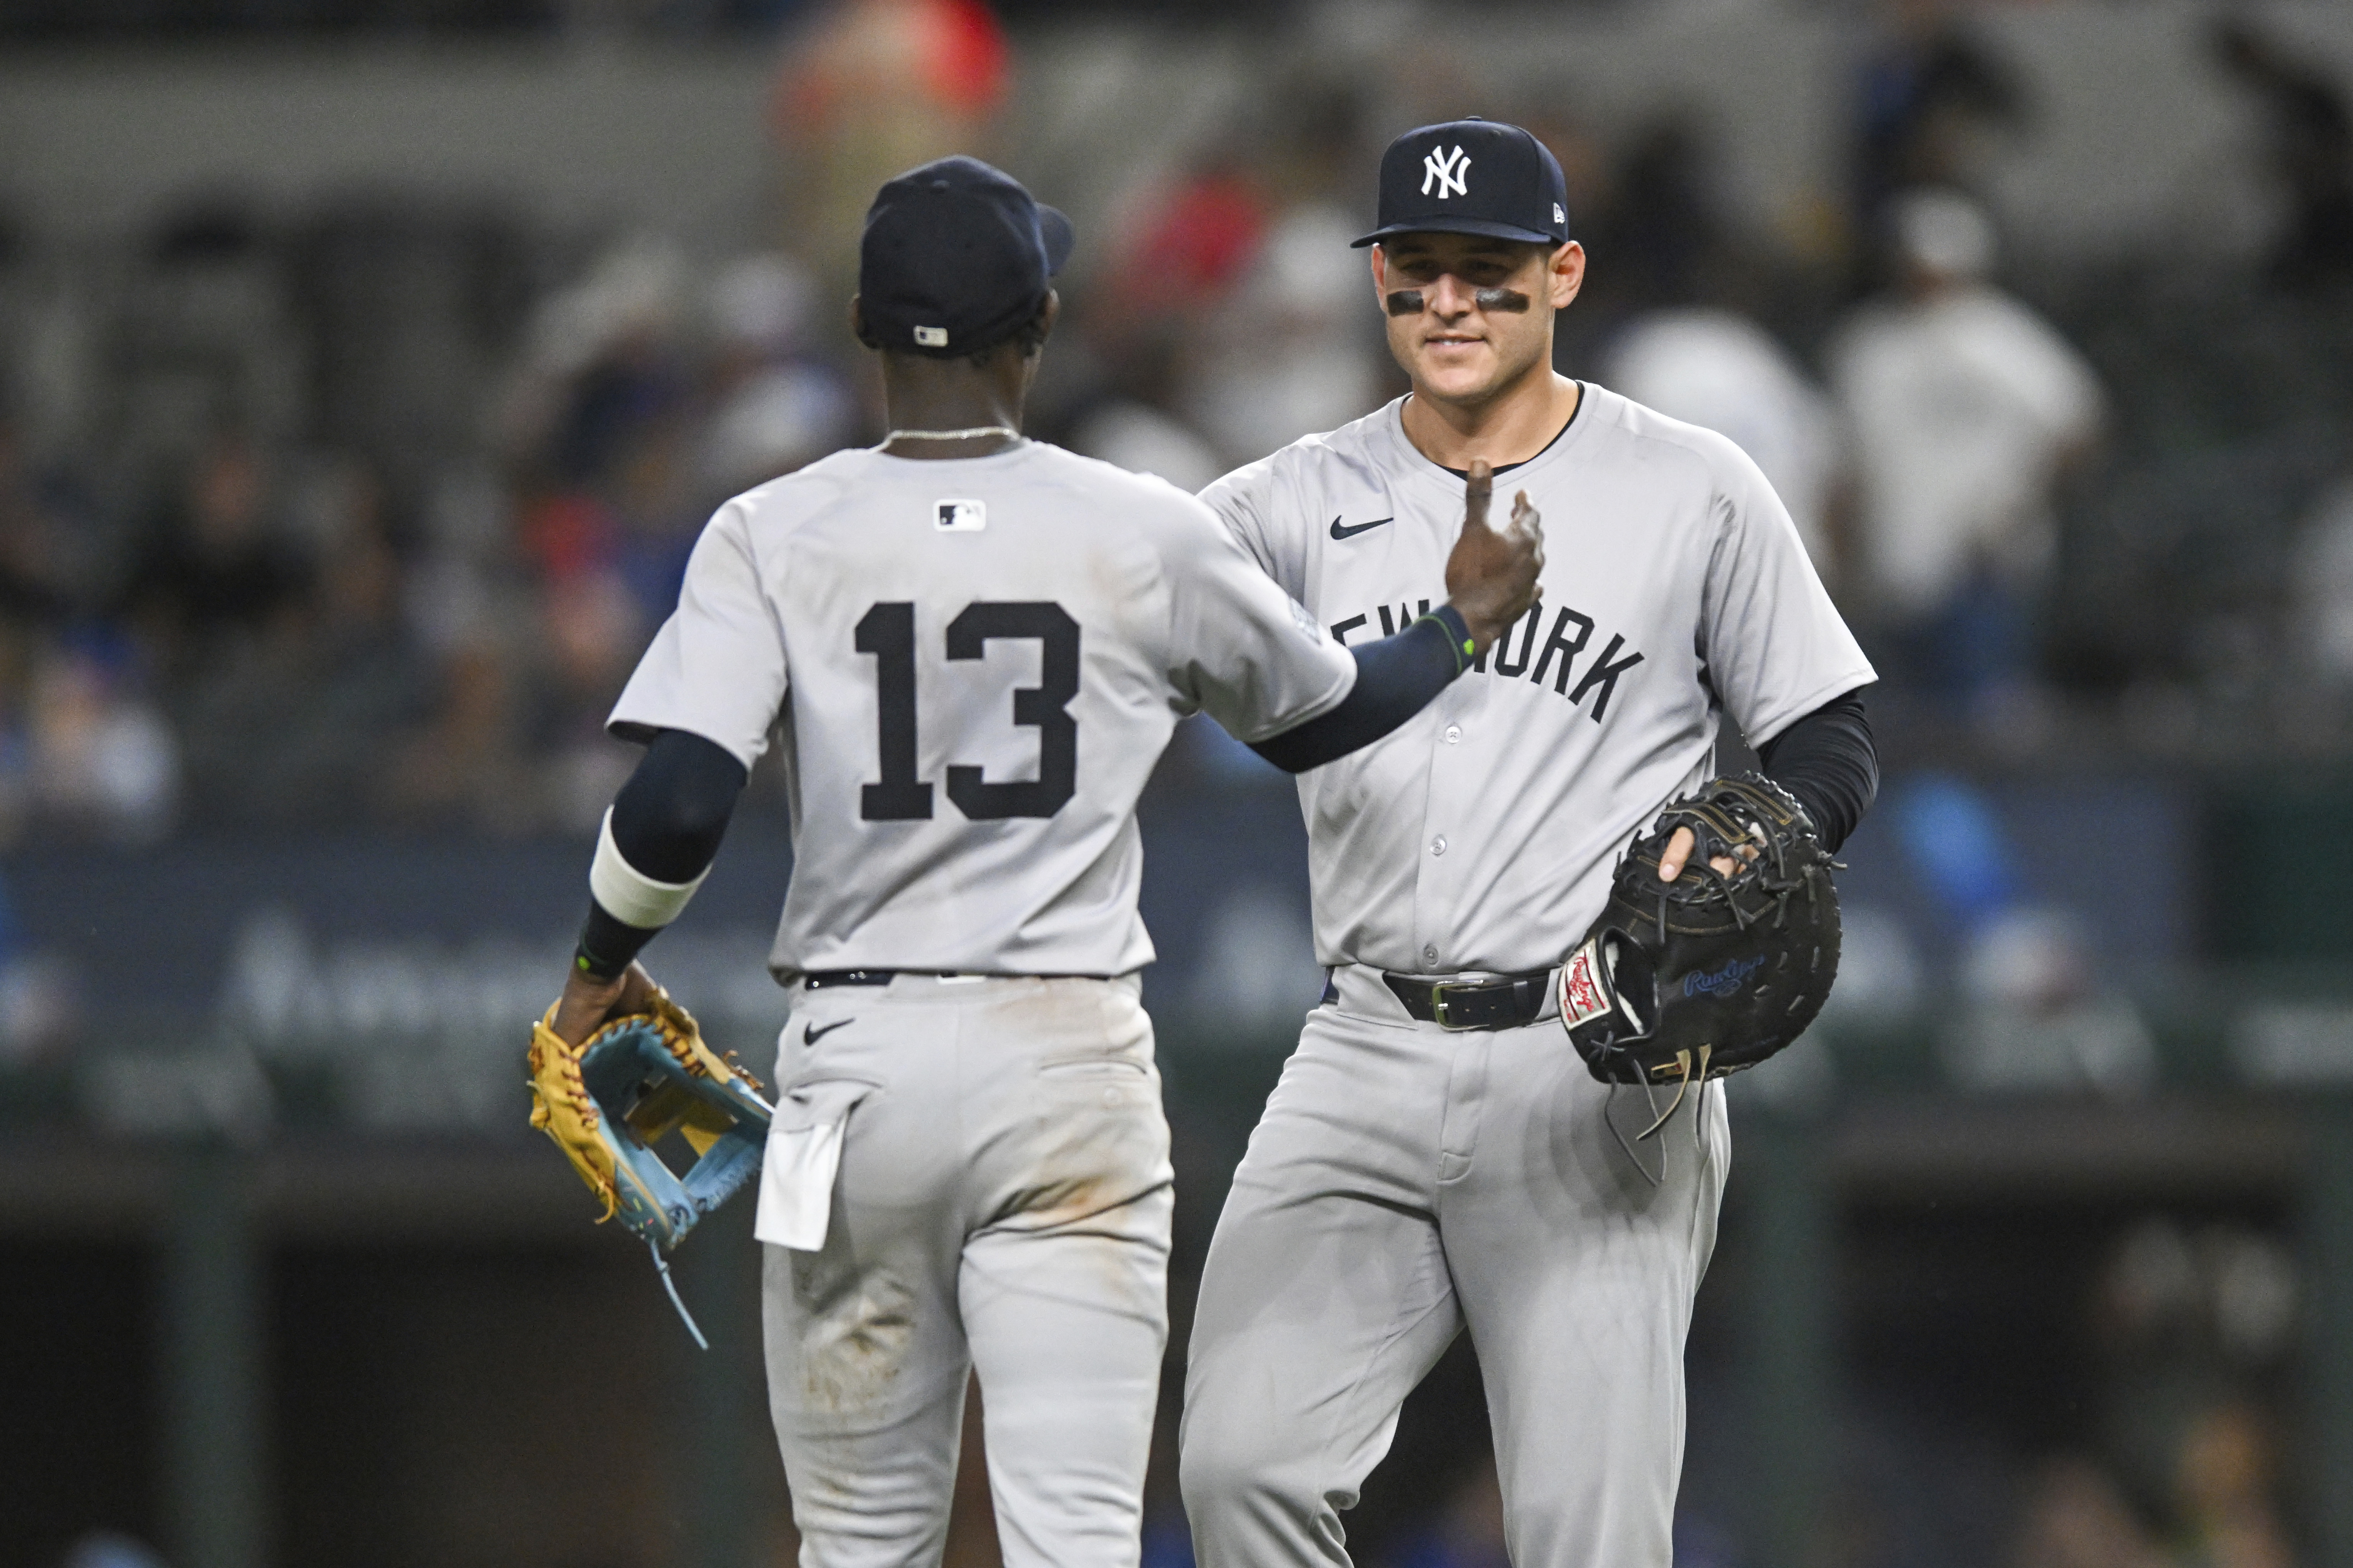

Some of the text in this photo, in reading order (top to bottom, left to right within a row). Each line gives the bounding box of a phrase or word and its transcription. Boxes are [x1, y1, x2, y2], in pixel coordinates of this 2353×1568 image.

[1421, 145, 1472, 199] NY
[854, 601, 1081, 820] 13
[1473, 599, 1645, 725] ORK
